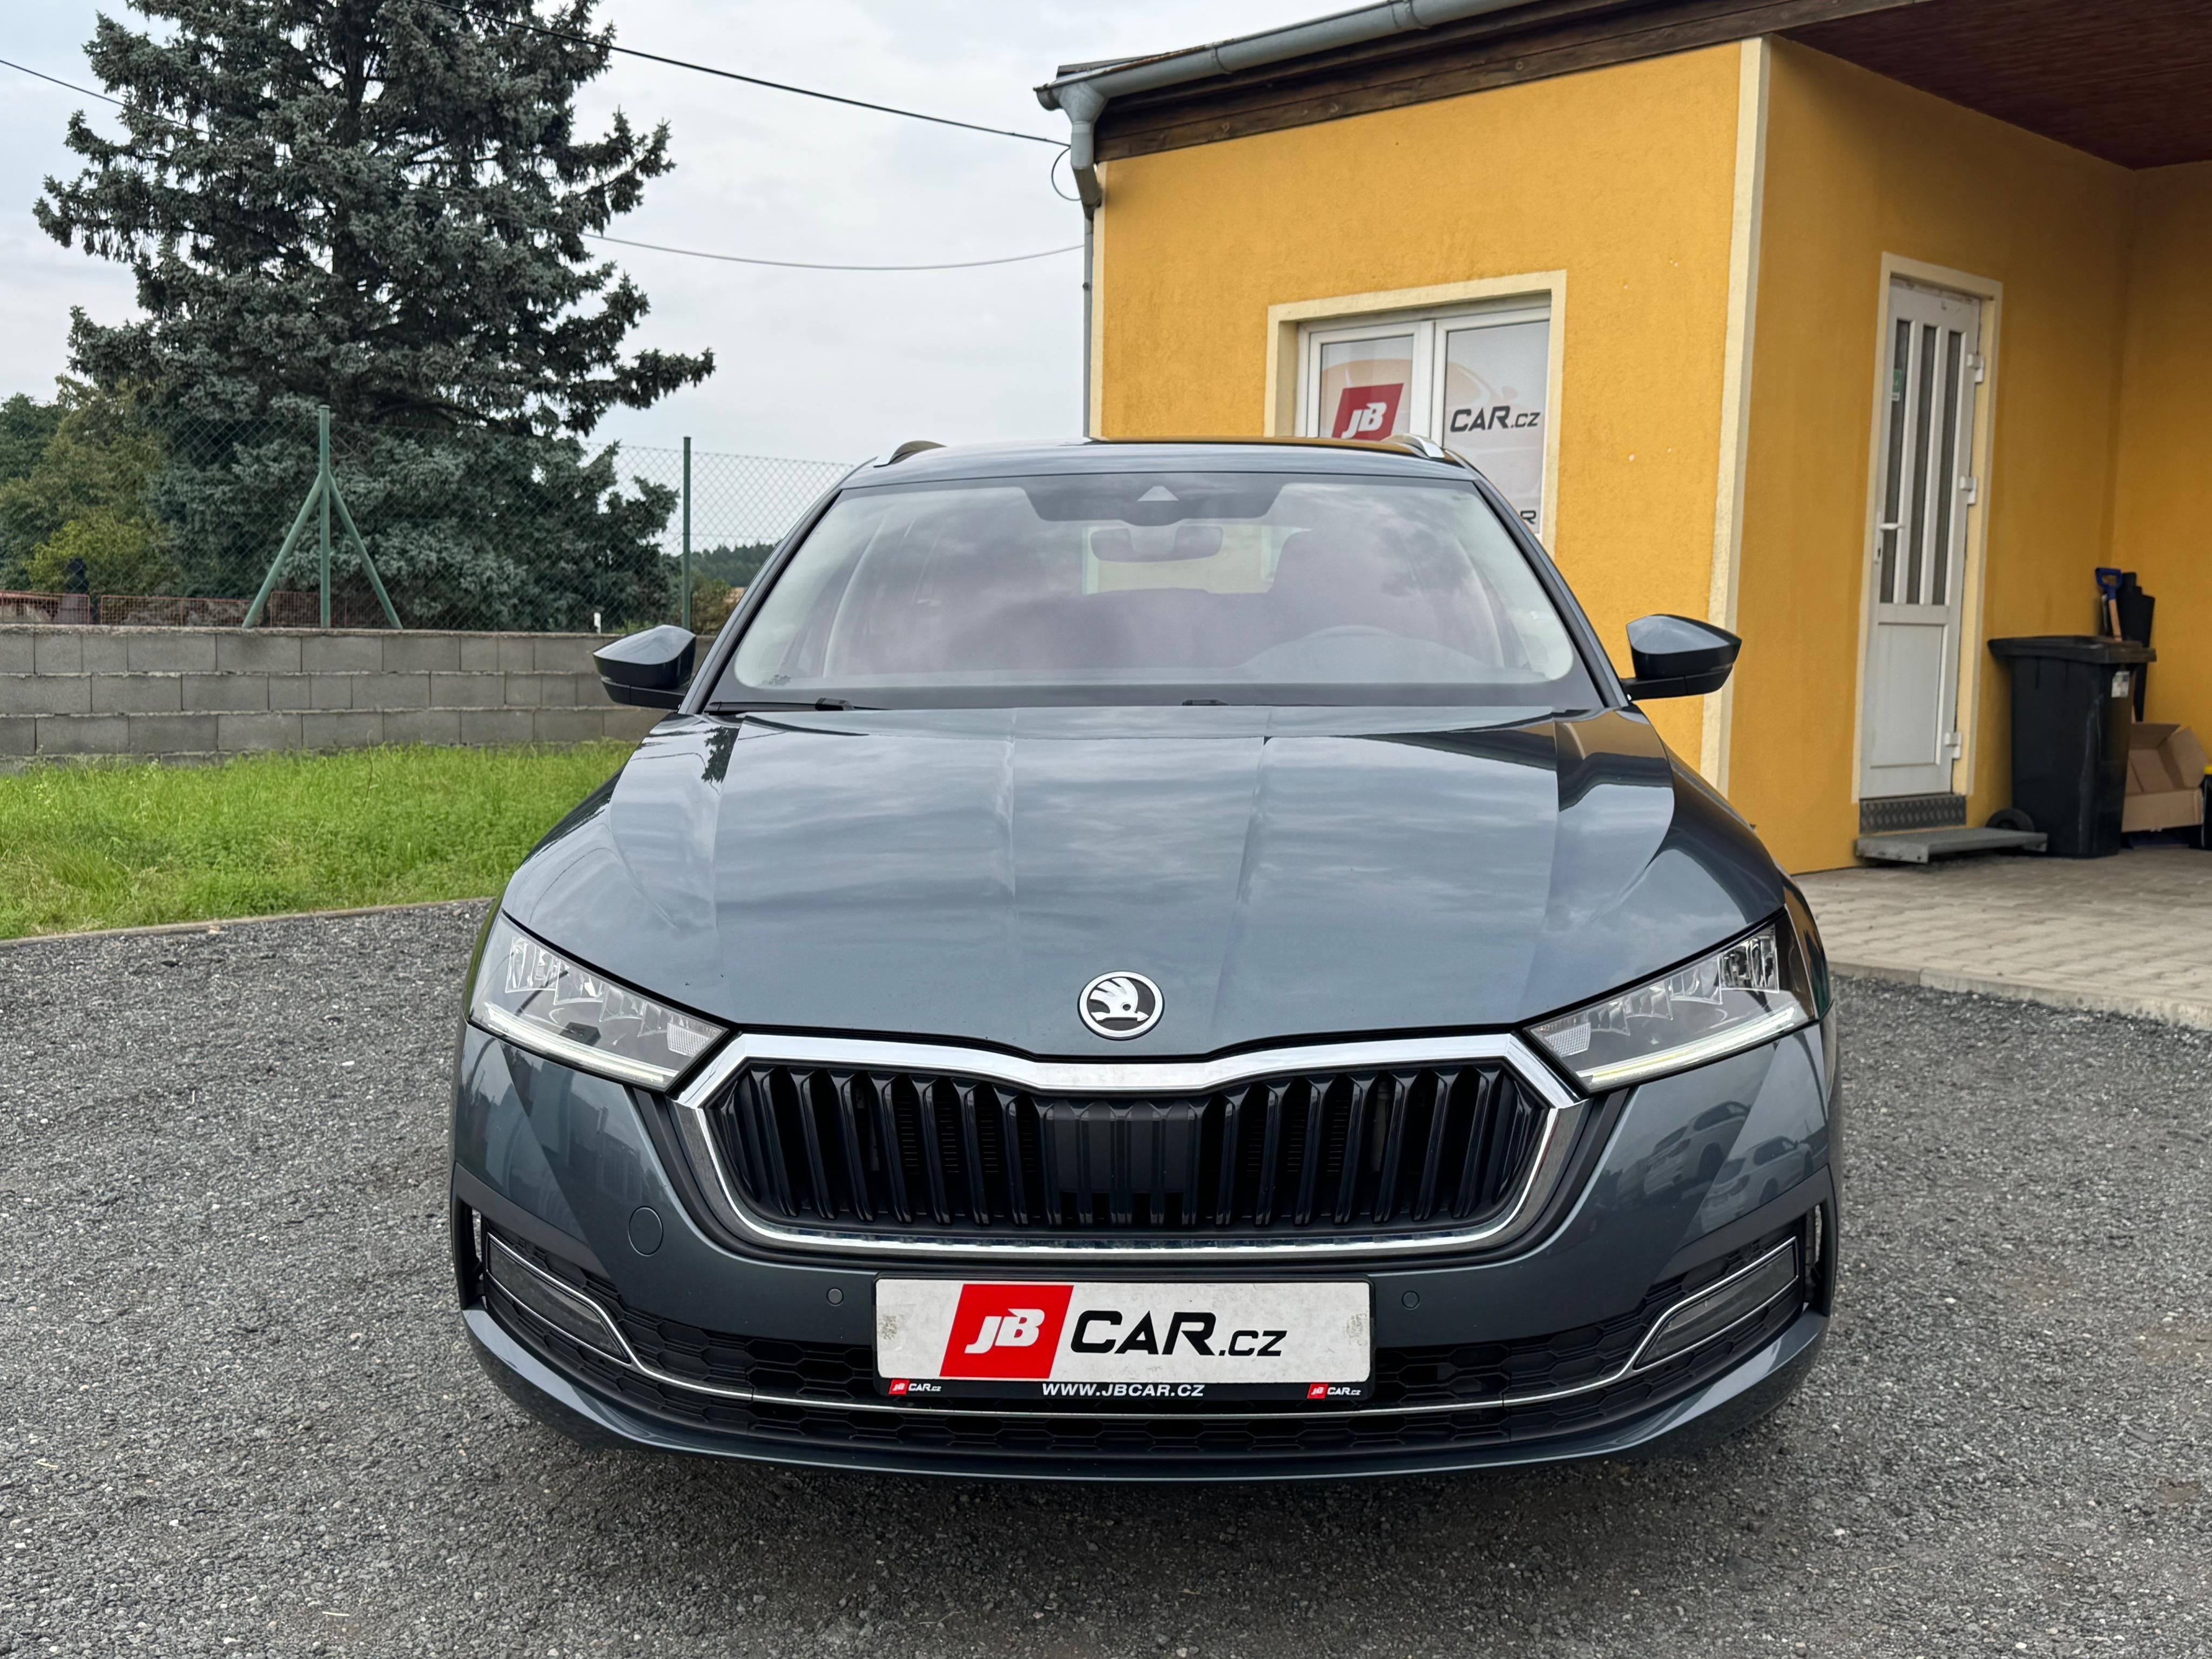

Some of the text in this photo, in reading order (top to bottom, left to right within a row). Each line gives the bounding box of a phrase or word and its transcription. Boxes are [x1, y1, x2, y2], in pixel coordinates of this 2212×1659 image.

[1341, 402, 1387, 439] JB
[964, 1308, 1045, 1354] JB
[1042, 1383, 1205, 1397] WWW.JBCAR.CZ
